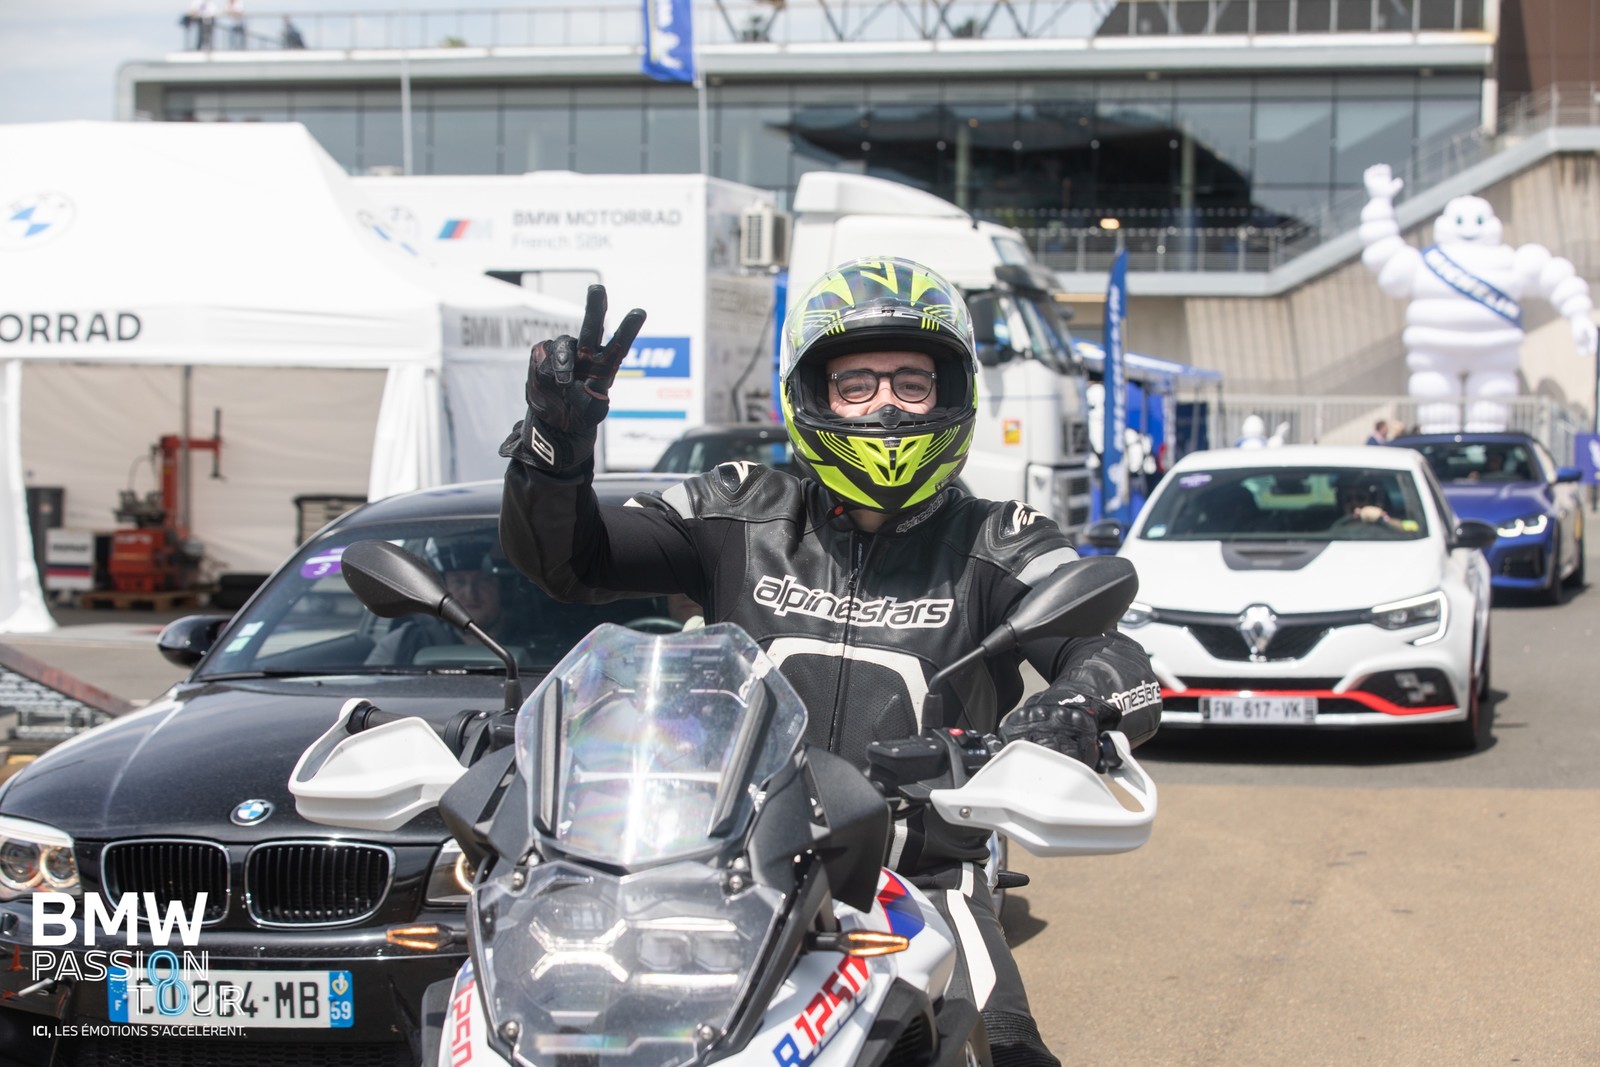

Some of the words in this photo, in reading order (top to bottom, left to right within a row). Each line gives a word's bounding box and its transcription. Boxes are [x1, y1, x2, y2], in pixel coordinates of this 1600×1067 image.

[753, 574, 954, 629] alpinestars
[1107, 680, 1162, 716] inestars
[331, 1001, 351, 1020] 59
